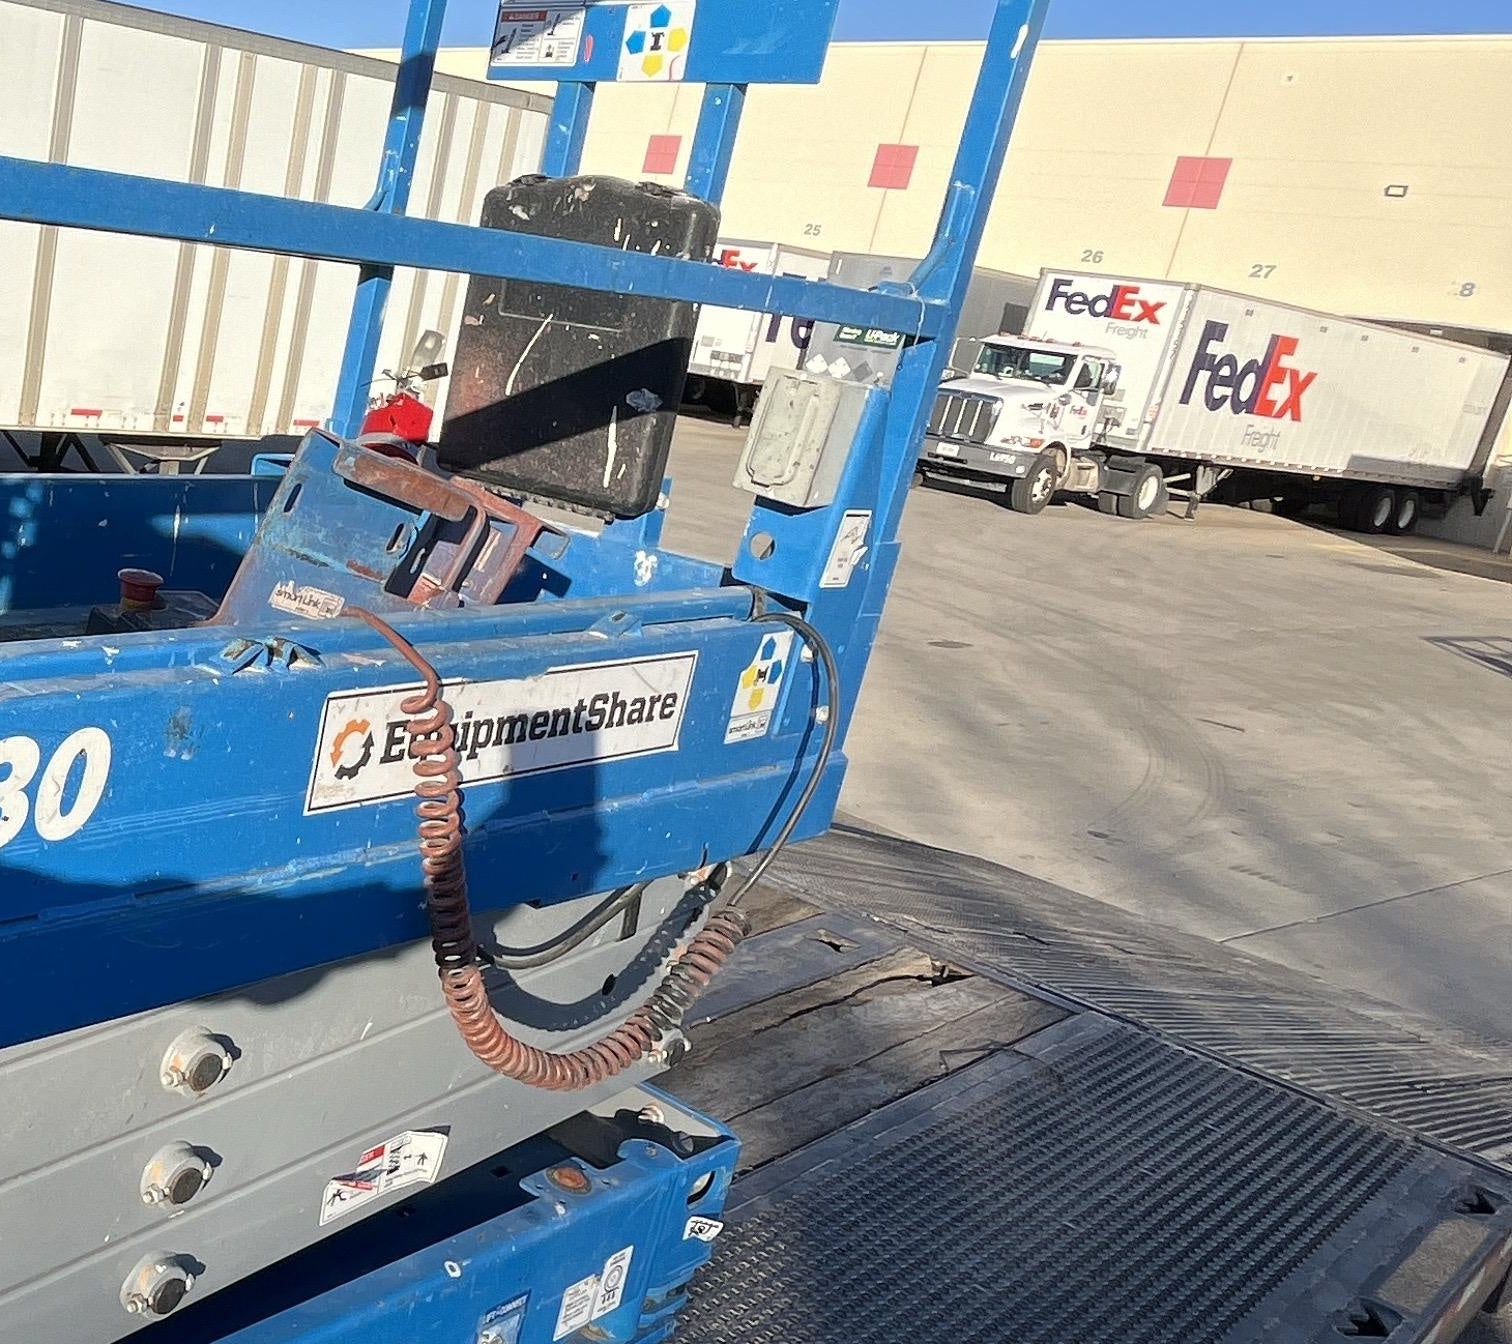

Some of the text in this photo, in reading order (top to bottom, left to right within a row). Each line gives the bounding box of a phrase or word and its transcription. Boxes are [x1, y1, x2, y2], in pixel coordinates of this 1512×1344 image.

[804, 223, 822, 236] 25
[1081, 249, 1104, 264] 26
[1248, 263, 1277, 279] 27
[1045, 278, 1168, 325] FedEx
[1105, 322, 1149, 340] Freight
[1179, 319, 1319, 422] FedEx
[1241, 424, 1281, 453] Freight
